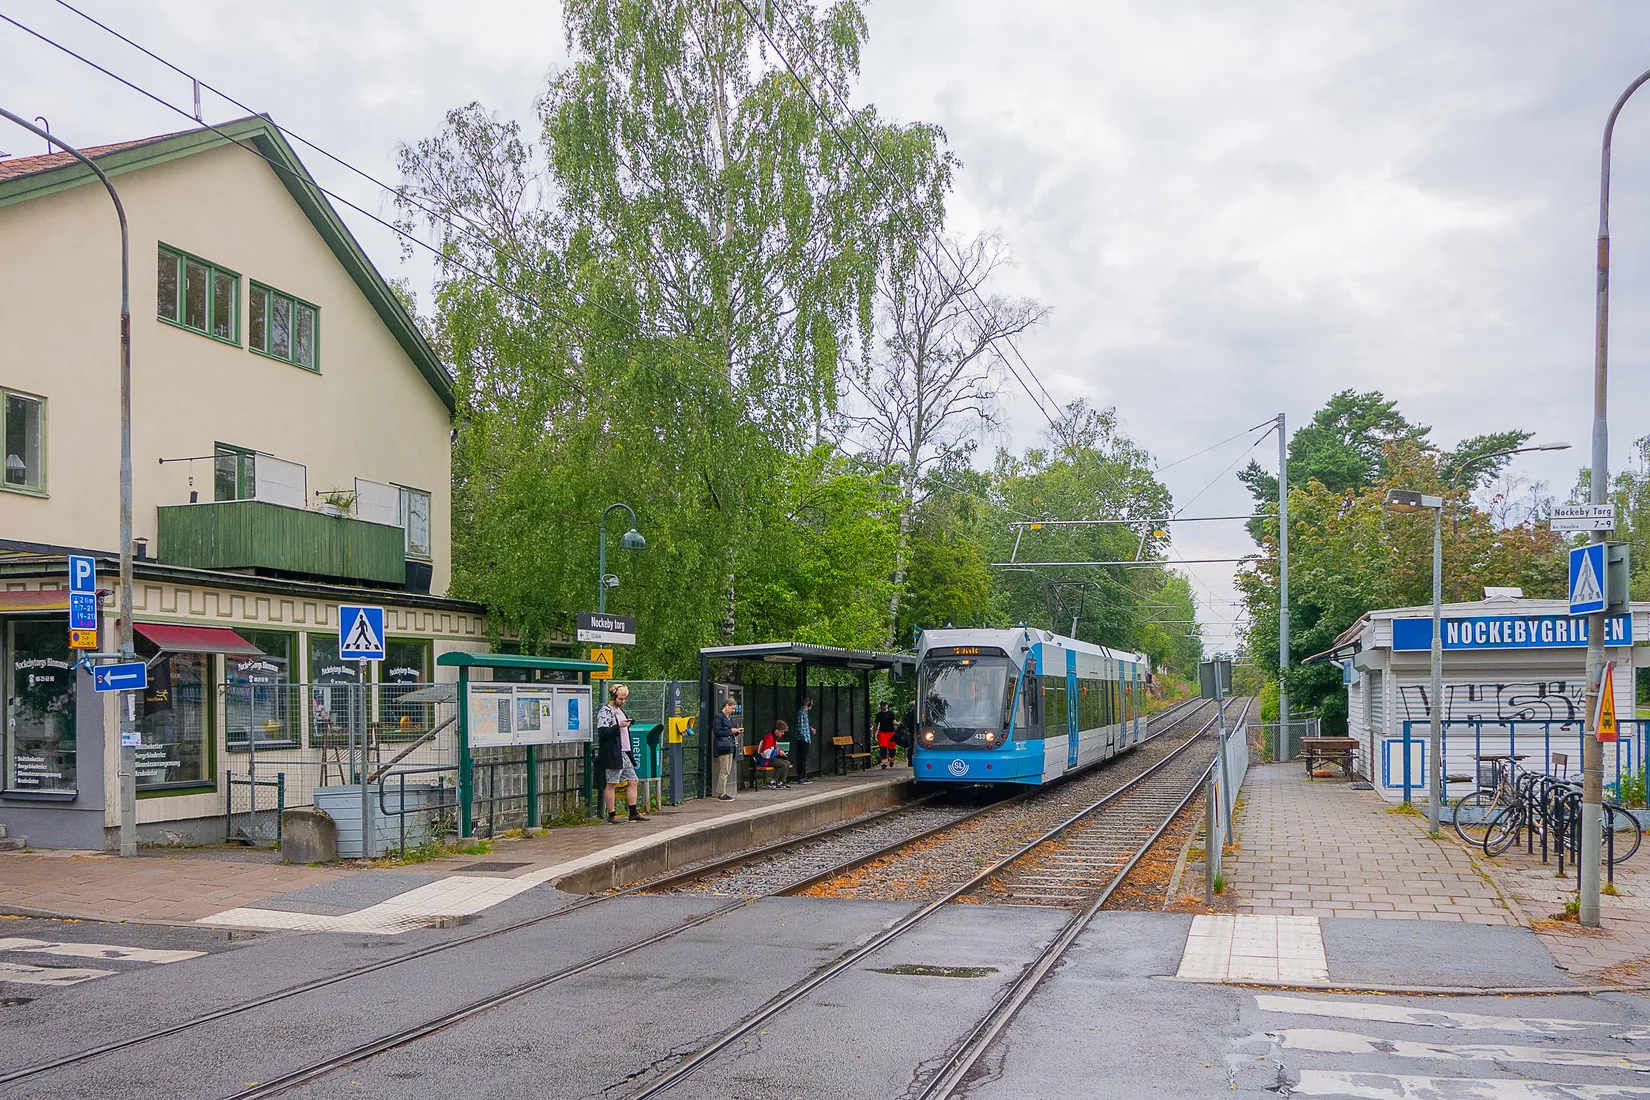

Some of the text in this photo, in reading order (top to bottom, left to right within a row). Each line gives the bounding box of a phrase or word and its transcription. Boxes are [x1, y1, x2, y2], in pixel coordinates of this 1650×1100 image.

[1554, 508, 1612, 518] Nockeby Torg
[76, 560, 91, 588] P
[591, 616, 625, 632] Nockeby torg
[1448, 618, 1624, 644] NOCKEBYGRILEN
[632, 737, 642, 770] metro
